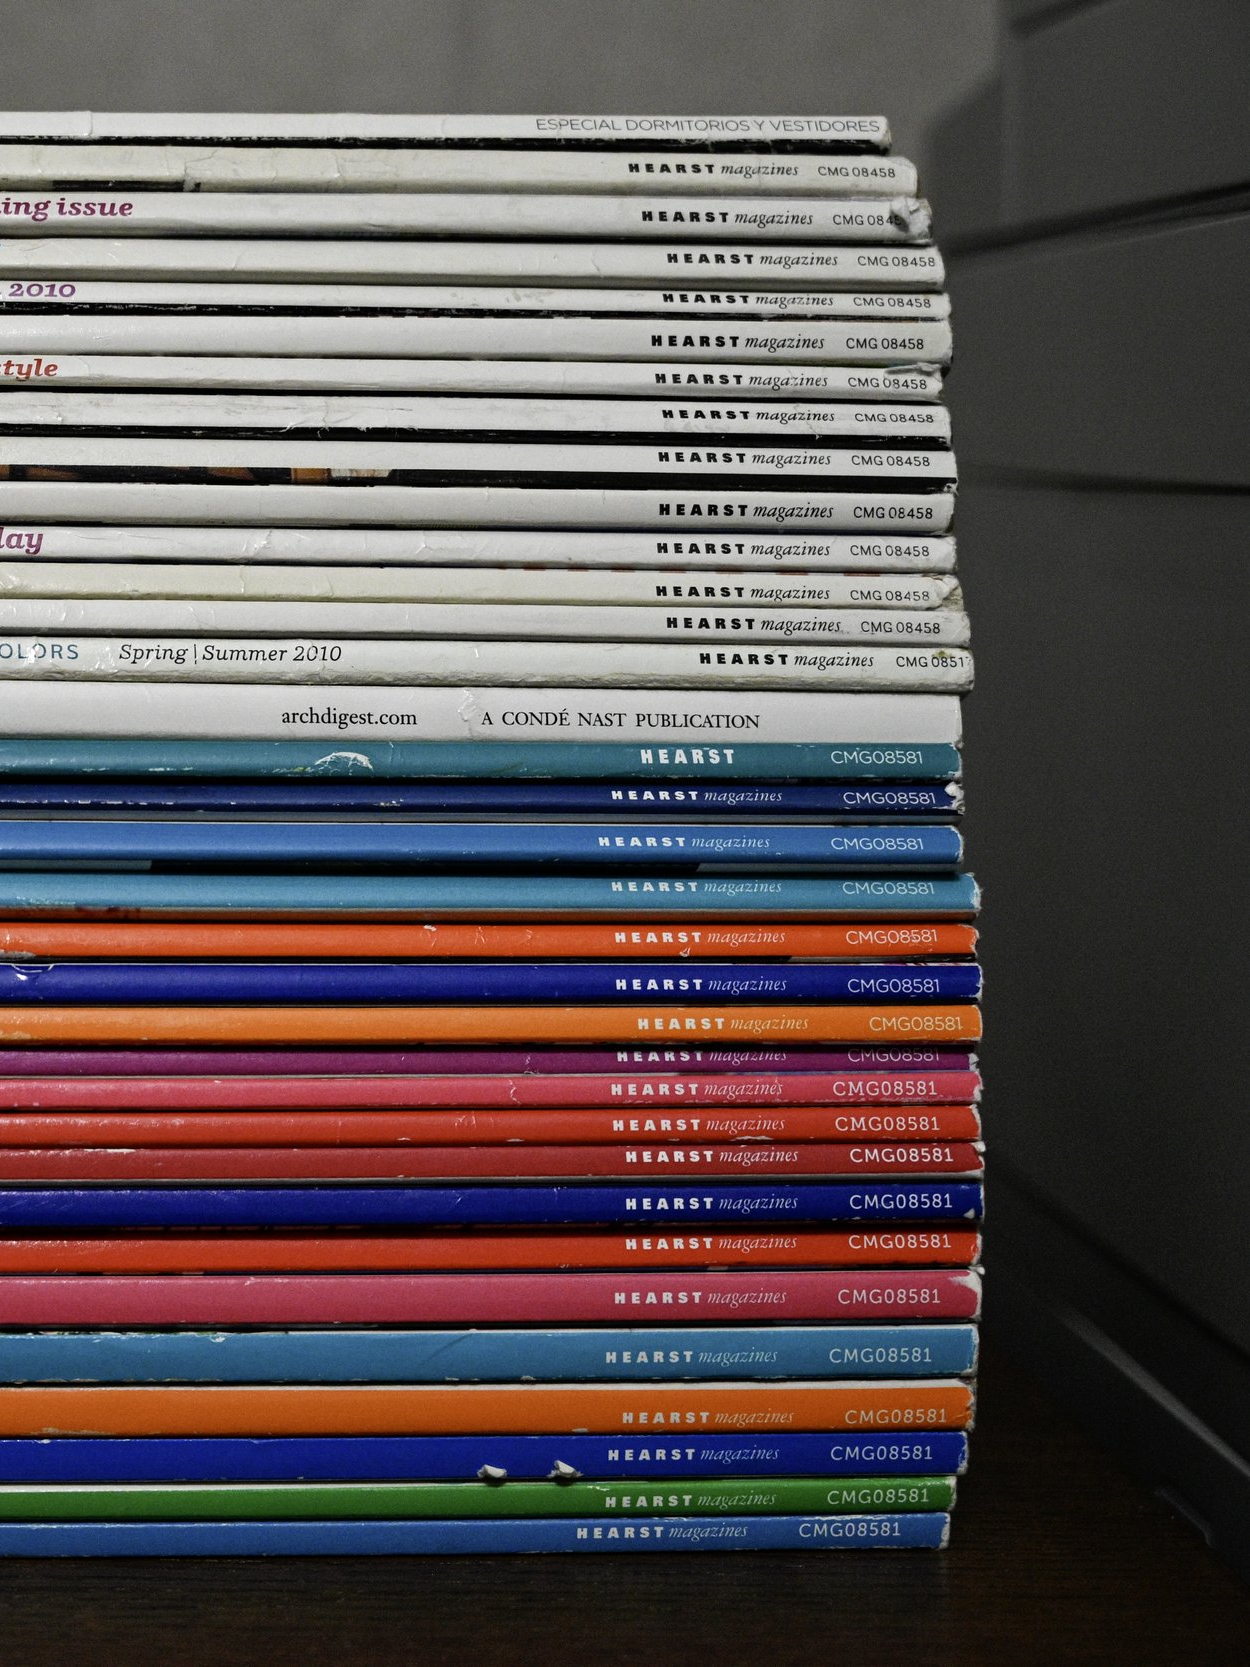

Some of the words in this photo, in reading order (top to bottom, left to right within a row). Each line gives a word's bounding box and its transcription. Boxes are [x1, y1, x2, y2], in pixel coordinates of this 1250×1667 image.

[536, 118, 621, 131] ESPECIAL
[625, 119, 749, 132] DORMITORIOS
[753, 120, 764, 131] Y
[769, 120, 880, 132] VESTIDORES
[629, 163, 714, 173] HEARST
[721, 163, 799, 178] magazines
[57, 199, 133, 216] issue
[667, 253, 754, 264] HEARST
[759, 253, 838, 268] magazines
[9, 283, 76, 298] 2010
[655, 374, 742, 384] HEARST
[749, 374, 828, 390] magazines
[662, 410, 749, 419] HEARST
[756, 410, 835, 424] magazines
[659, 504, 747, 516] HEARST
[753, 503, 833, 522] magazines
[667, 618, 754, 628] HEARST
[761, 617, 840, 635] magazines
[119, 644, 188, 664] Spring
[202, 645, 287, 662] Summer
[293, 645, 342, 662] 2010
[282, 708, 418, 728] archdigest.com
[482, 711, 493, 727] A
[502, 708, 569, 727] CONDÉ
[577, 711, 629, 728] NAST
[636, 712, 760, 729] PUBLICATION
[642, 749, 733, 764] HEARST
[830, 750, 923, 765] CMG08581
[612, 790, 698, 801] HEARST
[704, 789, 782, 805] magazines
[616, 980, 702, 989] HEARST
[708, 977, 787, 993] magazines
[848, 979, 940, 993] CMG08581
[626, 1198, 713, 1209] HEARST
[719, 1196, 798, 1213] magazines
[850, 1194, 952, 1209] CMG08581
[606, 1352, 693, 1363] HEARST
[699, 1349, 777, 1366] magazines
[829, 1348, 932, 1363] CMG08581
[577, 1527, 663, 1539] HEARST
[669, 1524, 747, 1541] magazines
